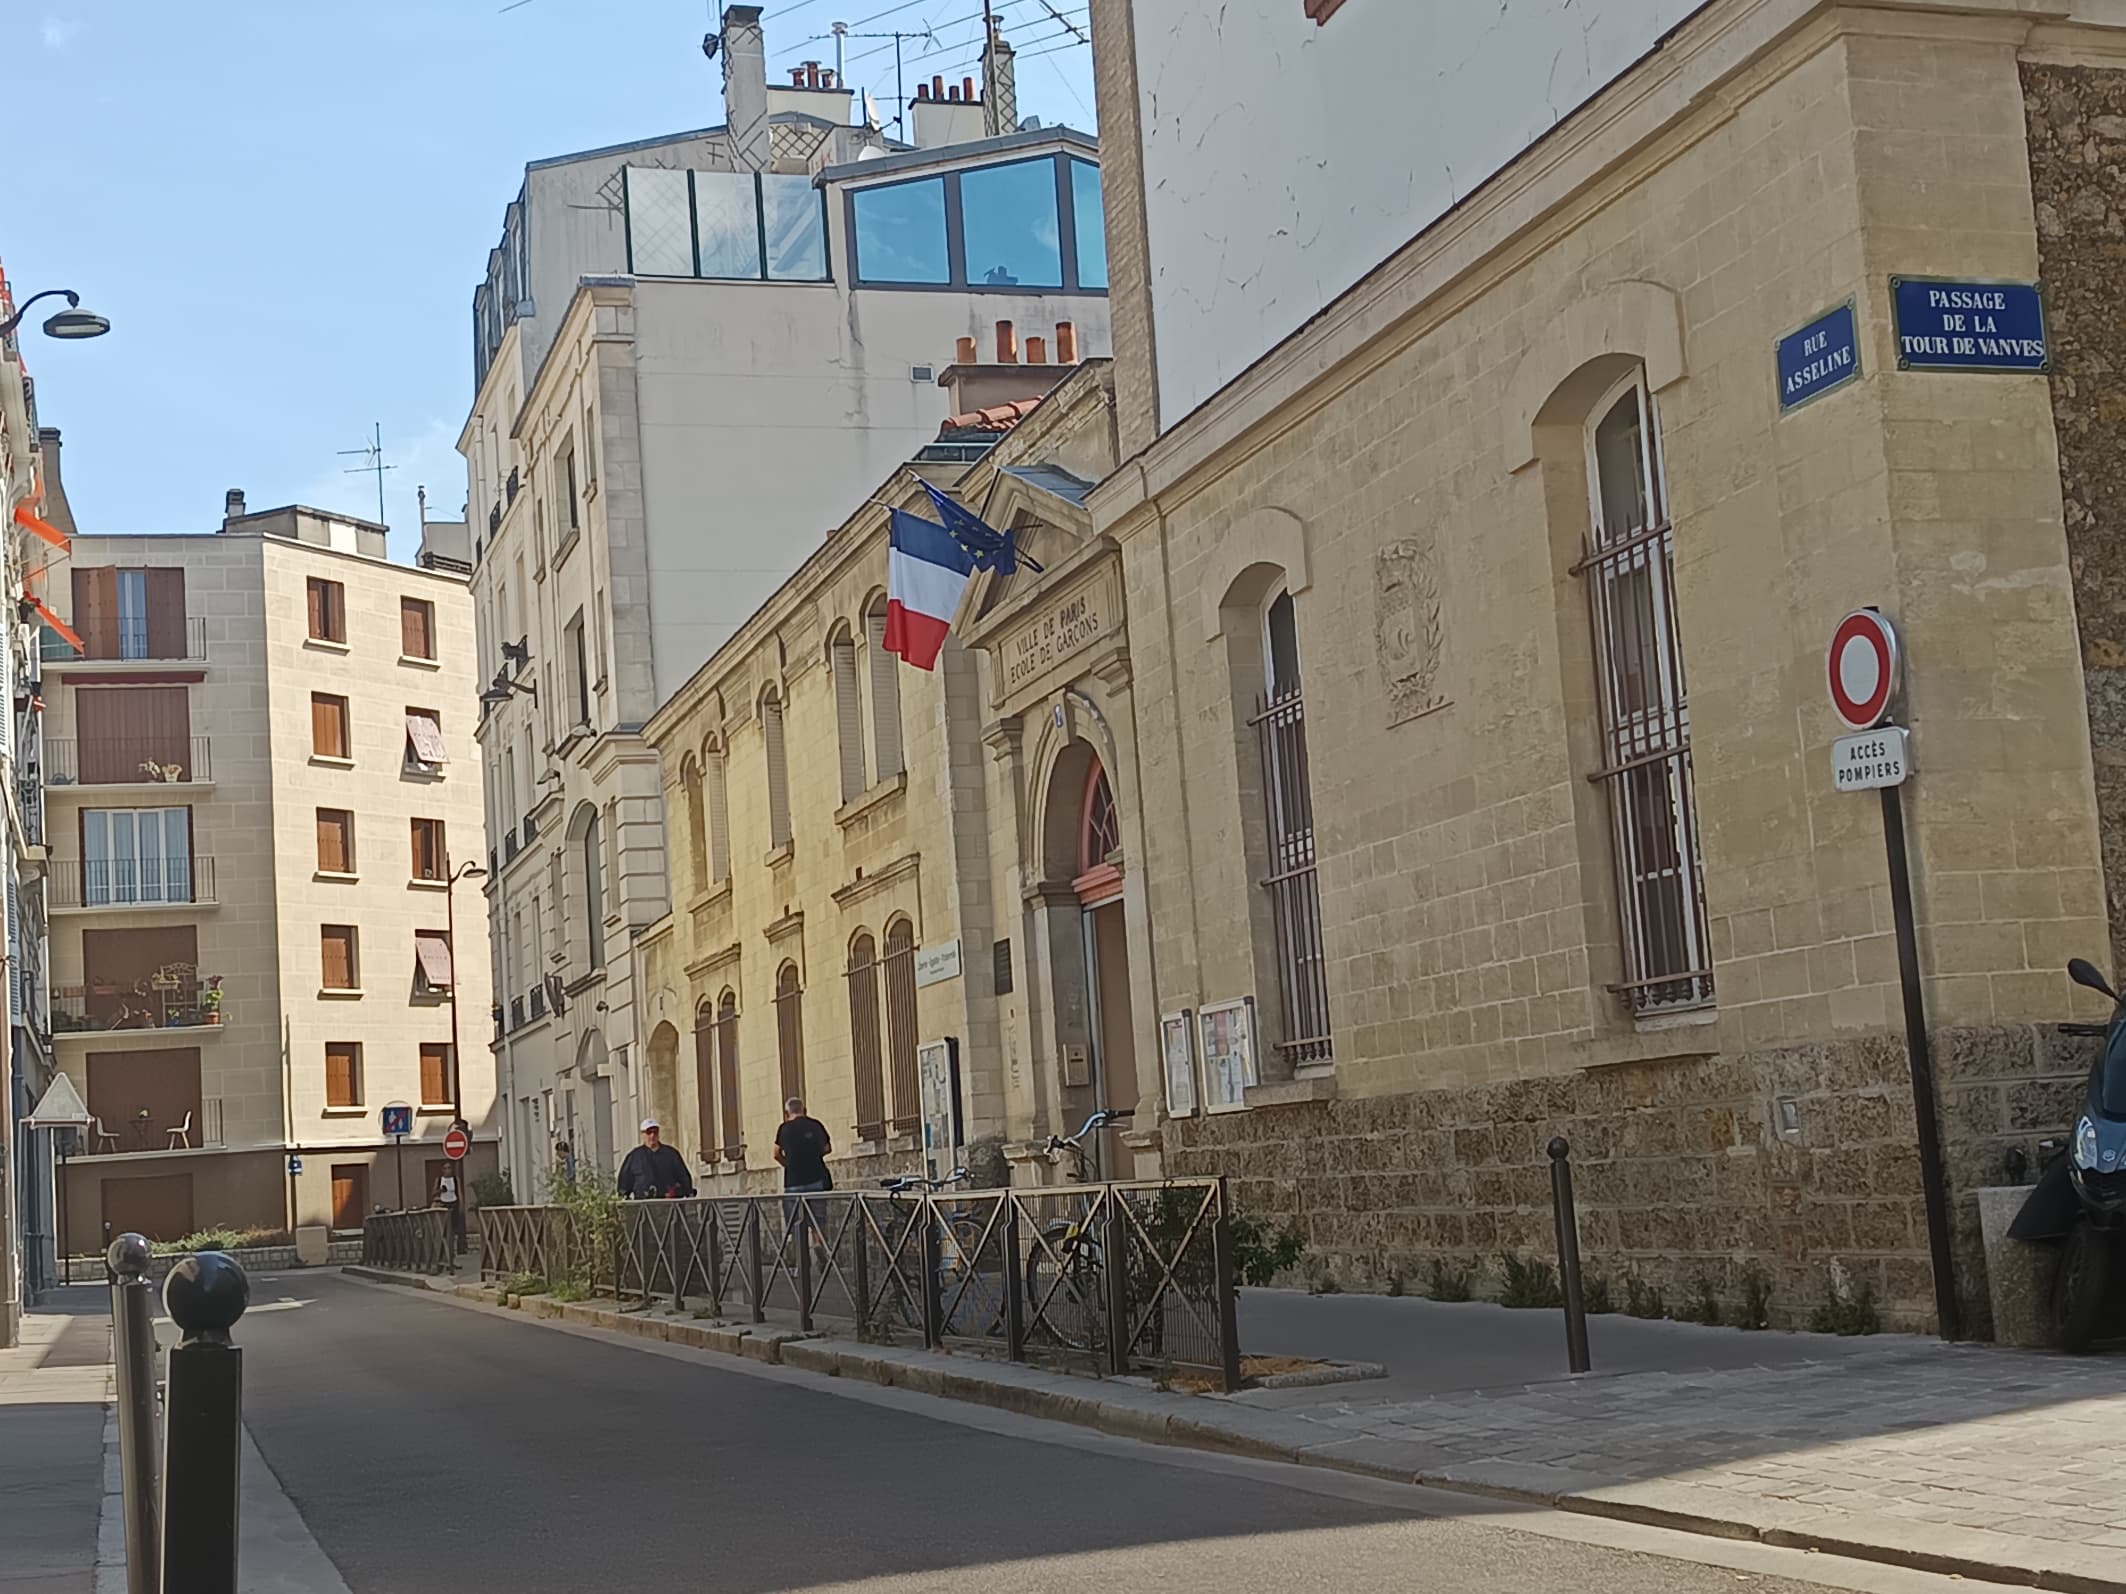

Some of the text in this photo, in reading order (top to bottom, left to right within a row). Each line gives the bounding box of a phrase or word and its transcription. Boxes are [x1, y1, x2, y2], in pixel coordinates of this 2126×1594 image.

[1929, 290, 2006, 309] PASSAGE
[1943, 315, 1997, 333] DE LA
[1804, 331, 1828, 357] RUE
[1901, 336, 2044, 357] TOUR DE VANVES
[1786, 346, 1851, 395] ASSELINE
[1016, 596, 1086, 656] VILLE DE PARIS
[1040, 643, 1052, 665] DE
[1850, 740, 1886, 761] ACCÈS
[1839, 761, 1900, 783] POMPIERS
